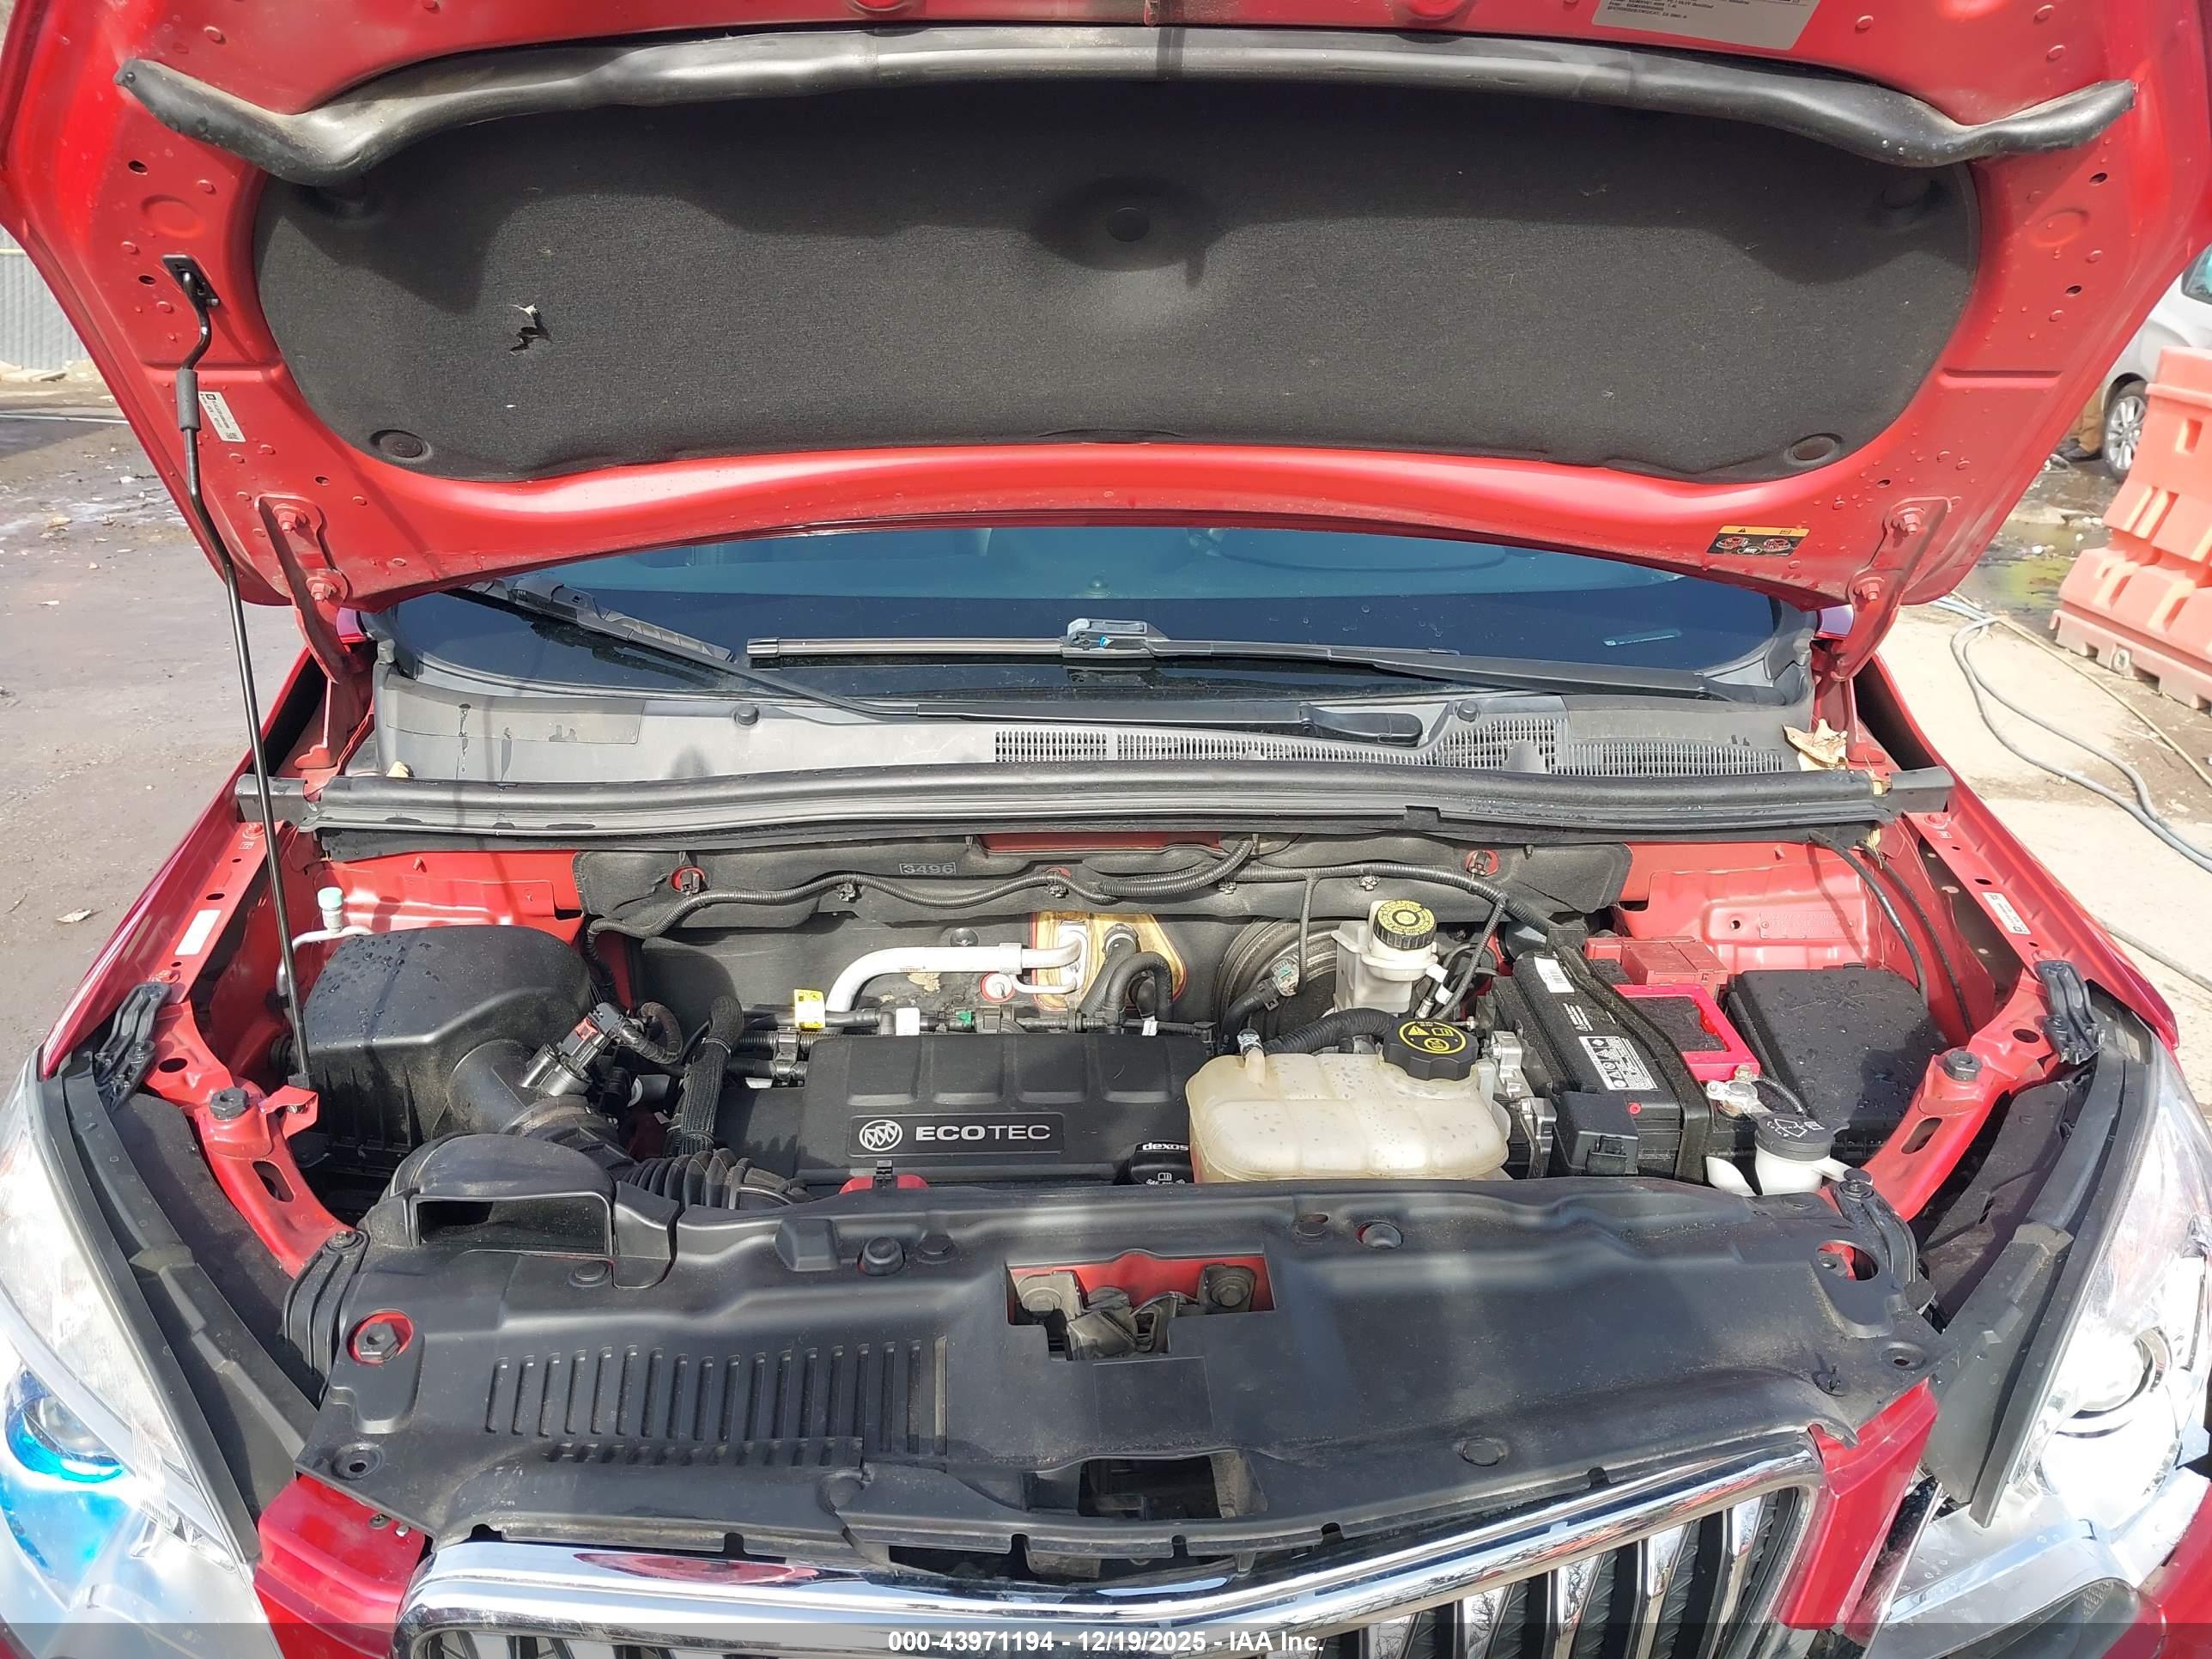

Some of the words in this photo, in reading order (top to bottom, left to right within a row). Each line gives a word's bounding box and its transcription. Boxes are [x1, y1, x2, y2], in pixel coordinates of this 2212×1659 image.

[902, 864, 954, 874] 3496
[915, 1125, 1050, 1141] ECOTEC
[1142, 1142, 1188, 1151] dexos
